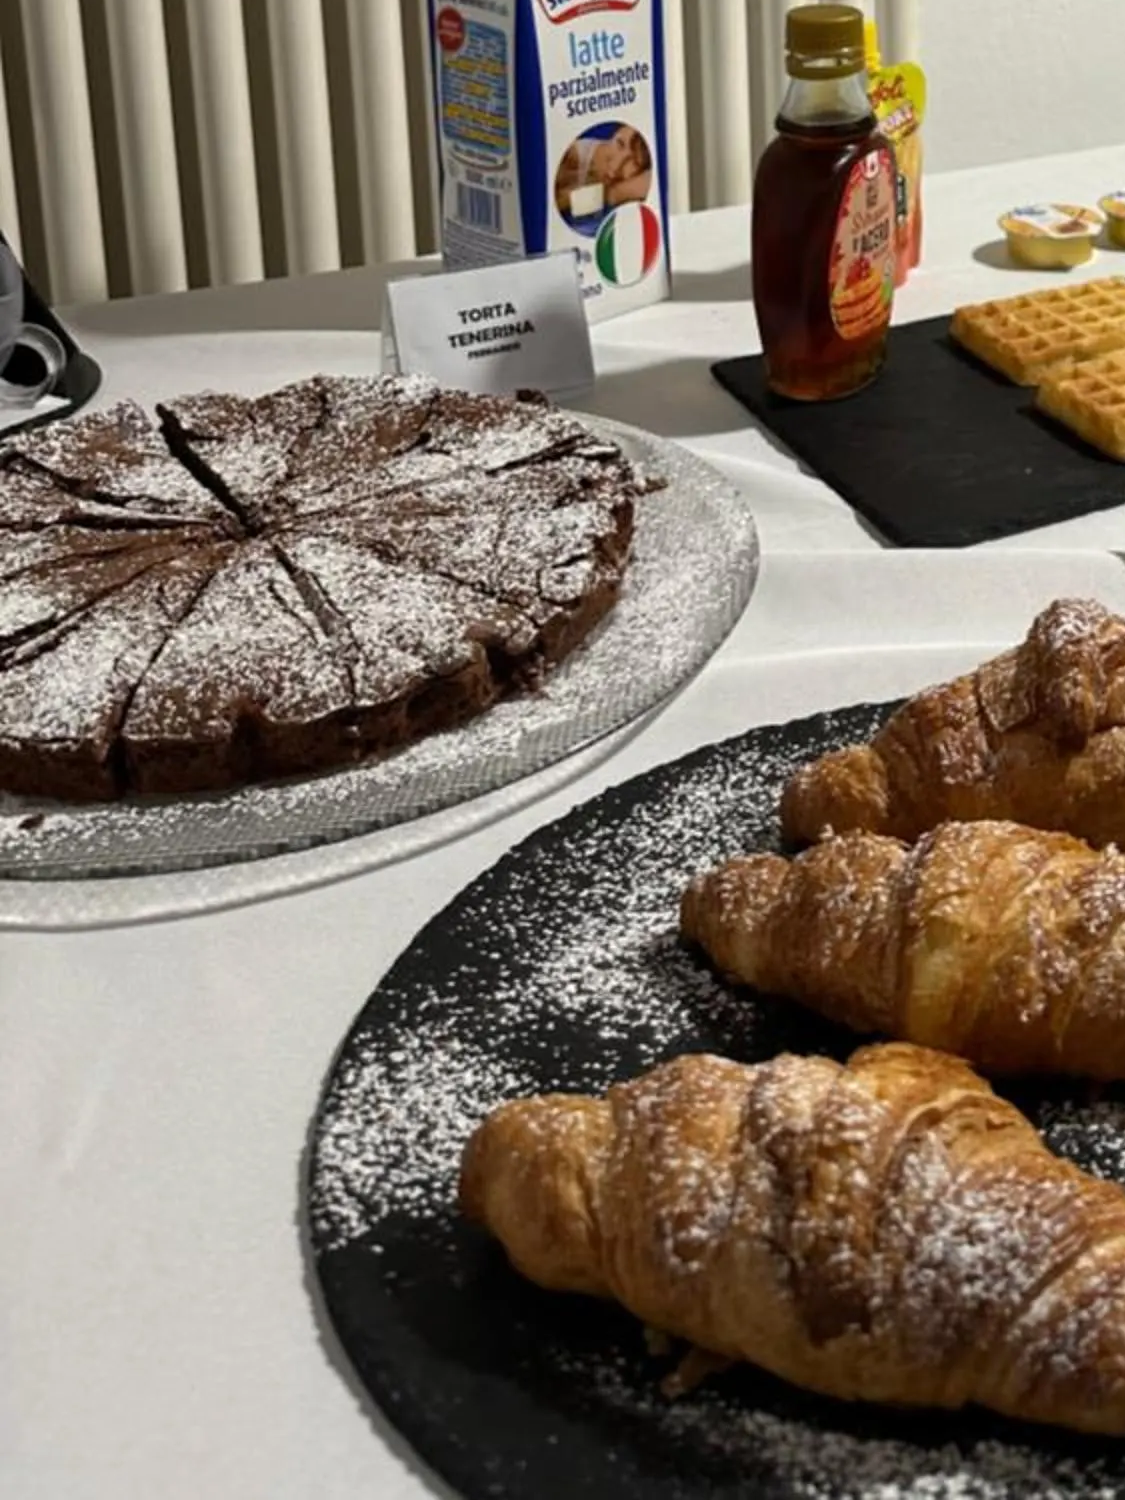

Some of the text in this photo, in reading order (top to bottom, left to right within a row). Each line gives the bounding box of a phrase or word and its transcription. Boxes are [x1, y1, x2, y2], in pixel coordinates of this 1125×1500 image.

[569, 30, 625, 68] latte
[548, 60, 650, 107] parzialmente
[567, 85, 637, 119] scremato
[457, 302, 517, 325] TORTA
[447, 319, 535, 349] TENERINA
